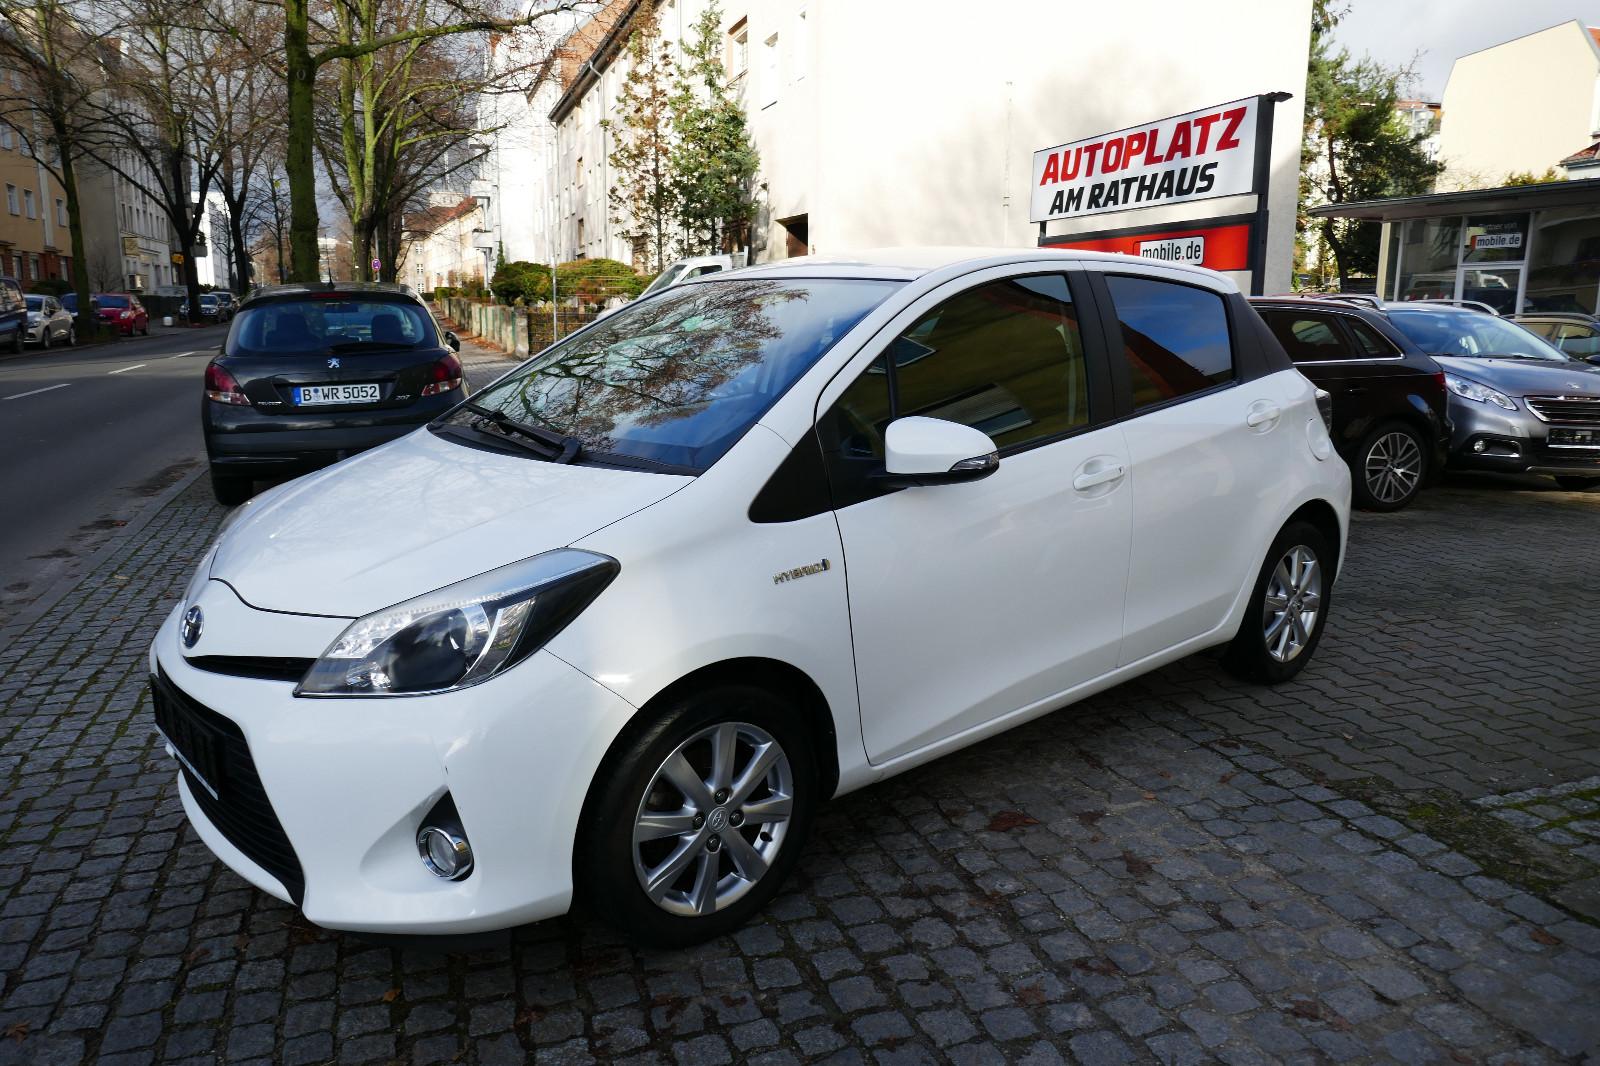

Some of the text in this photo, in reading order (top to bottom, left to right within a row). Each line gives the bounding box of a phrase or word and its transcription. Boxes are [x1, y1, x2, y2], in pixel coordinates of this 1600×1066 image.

[1040, 106, 1248, 186] AUTOPLATZ
[1049, 162, 1218, 215] AM RATHAUS
[1477, 235, 1519, 246] mobile.de
[1142, 241, 1201, 260] mobile.de
[302, 389, 312, 401] B
[321, 388, 340, 400] WR
[343, 386, 377, 399] 5052
